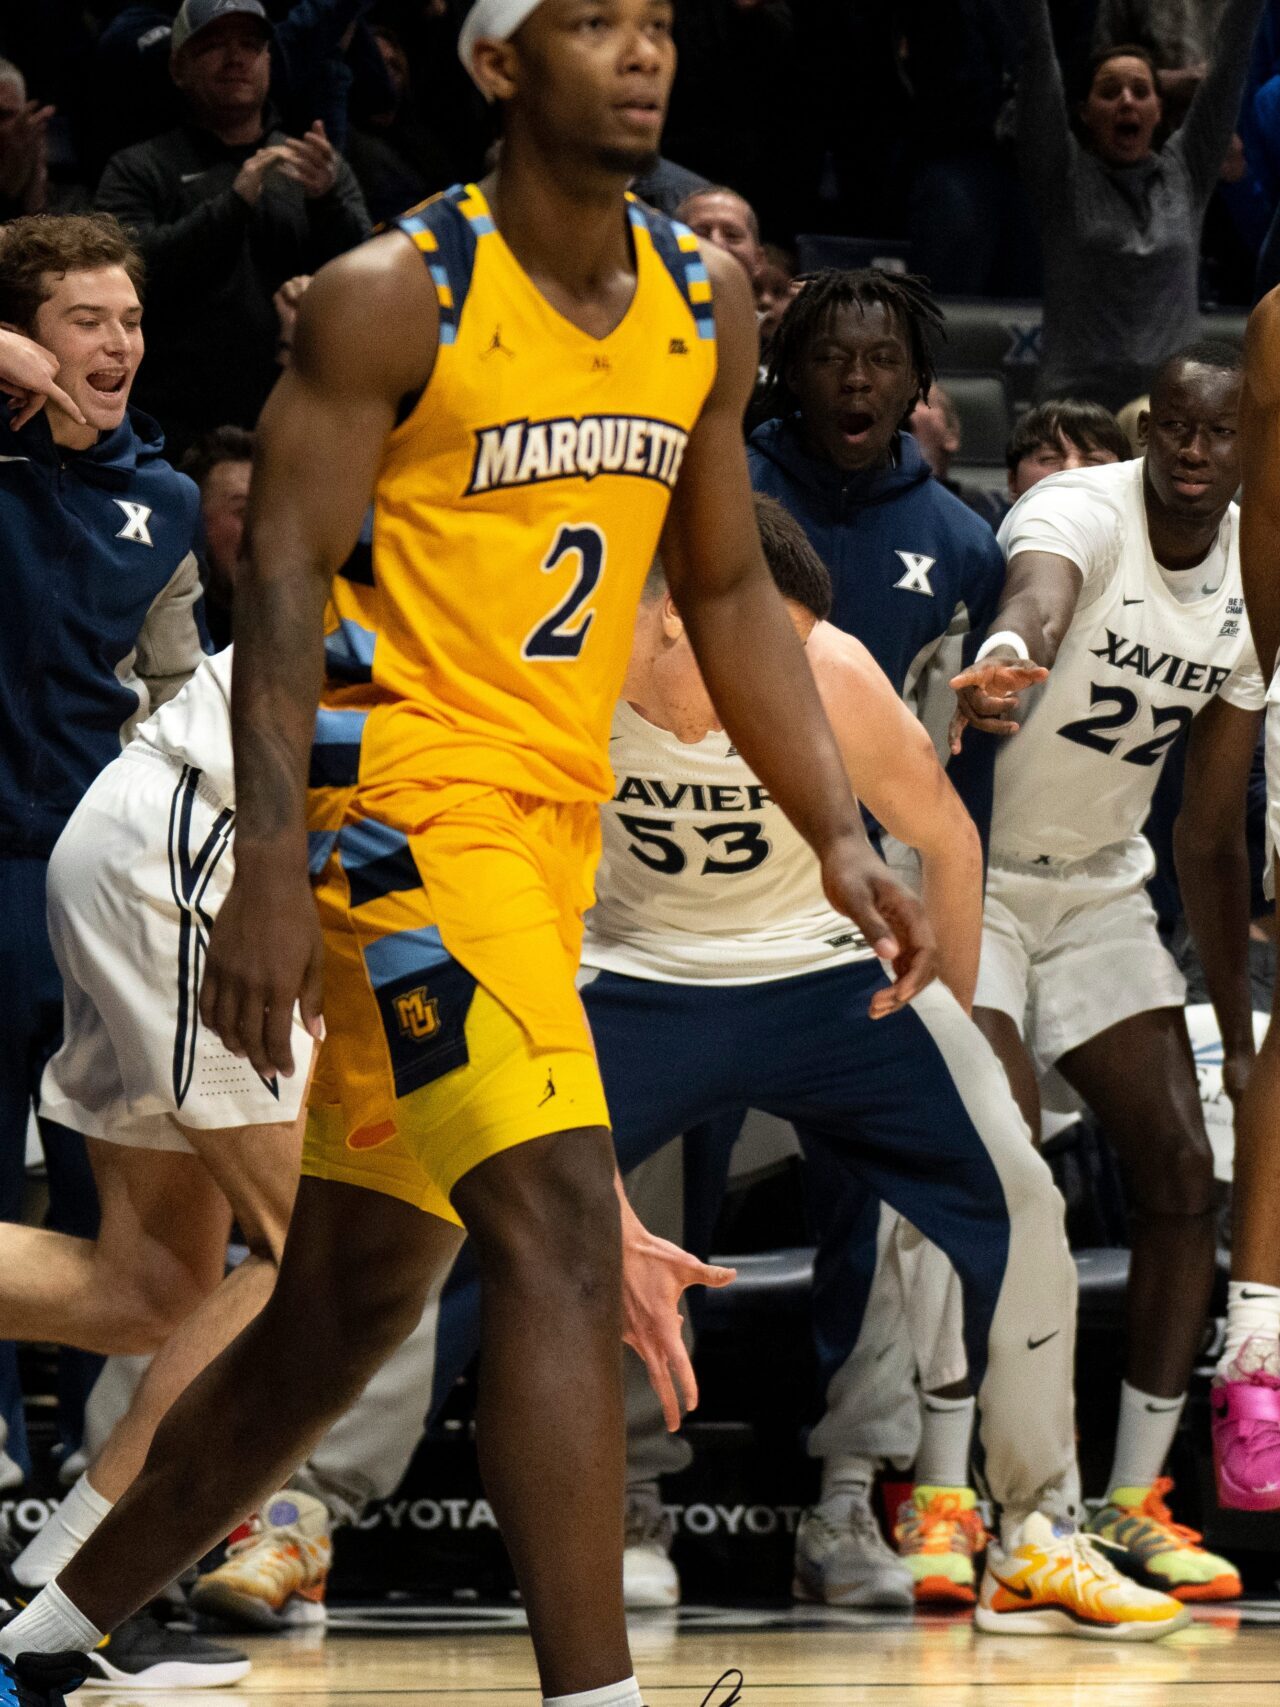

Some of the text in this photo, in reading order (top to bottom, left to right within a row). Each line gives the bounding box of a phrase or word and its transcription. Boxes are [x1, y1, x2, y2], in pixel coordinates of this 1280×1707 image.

[112, 498, 154, 548] X
[520, 521, 608, 662] 2
[892, 549, 937, 598] X
[1225, 605, 1244, 615] CHAN
[1089, 627, 1232, 694] XAVIER
[1056, 681, 1194, 766] 22
[613, 776, 776, 812] AVIER
[615, 812, 772, 876] 53
[392, 985, 442, 1042] MU
[356, 1498, 499, 1530] YOTA
[661, 1502, 803, 1535] TOYOT
